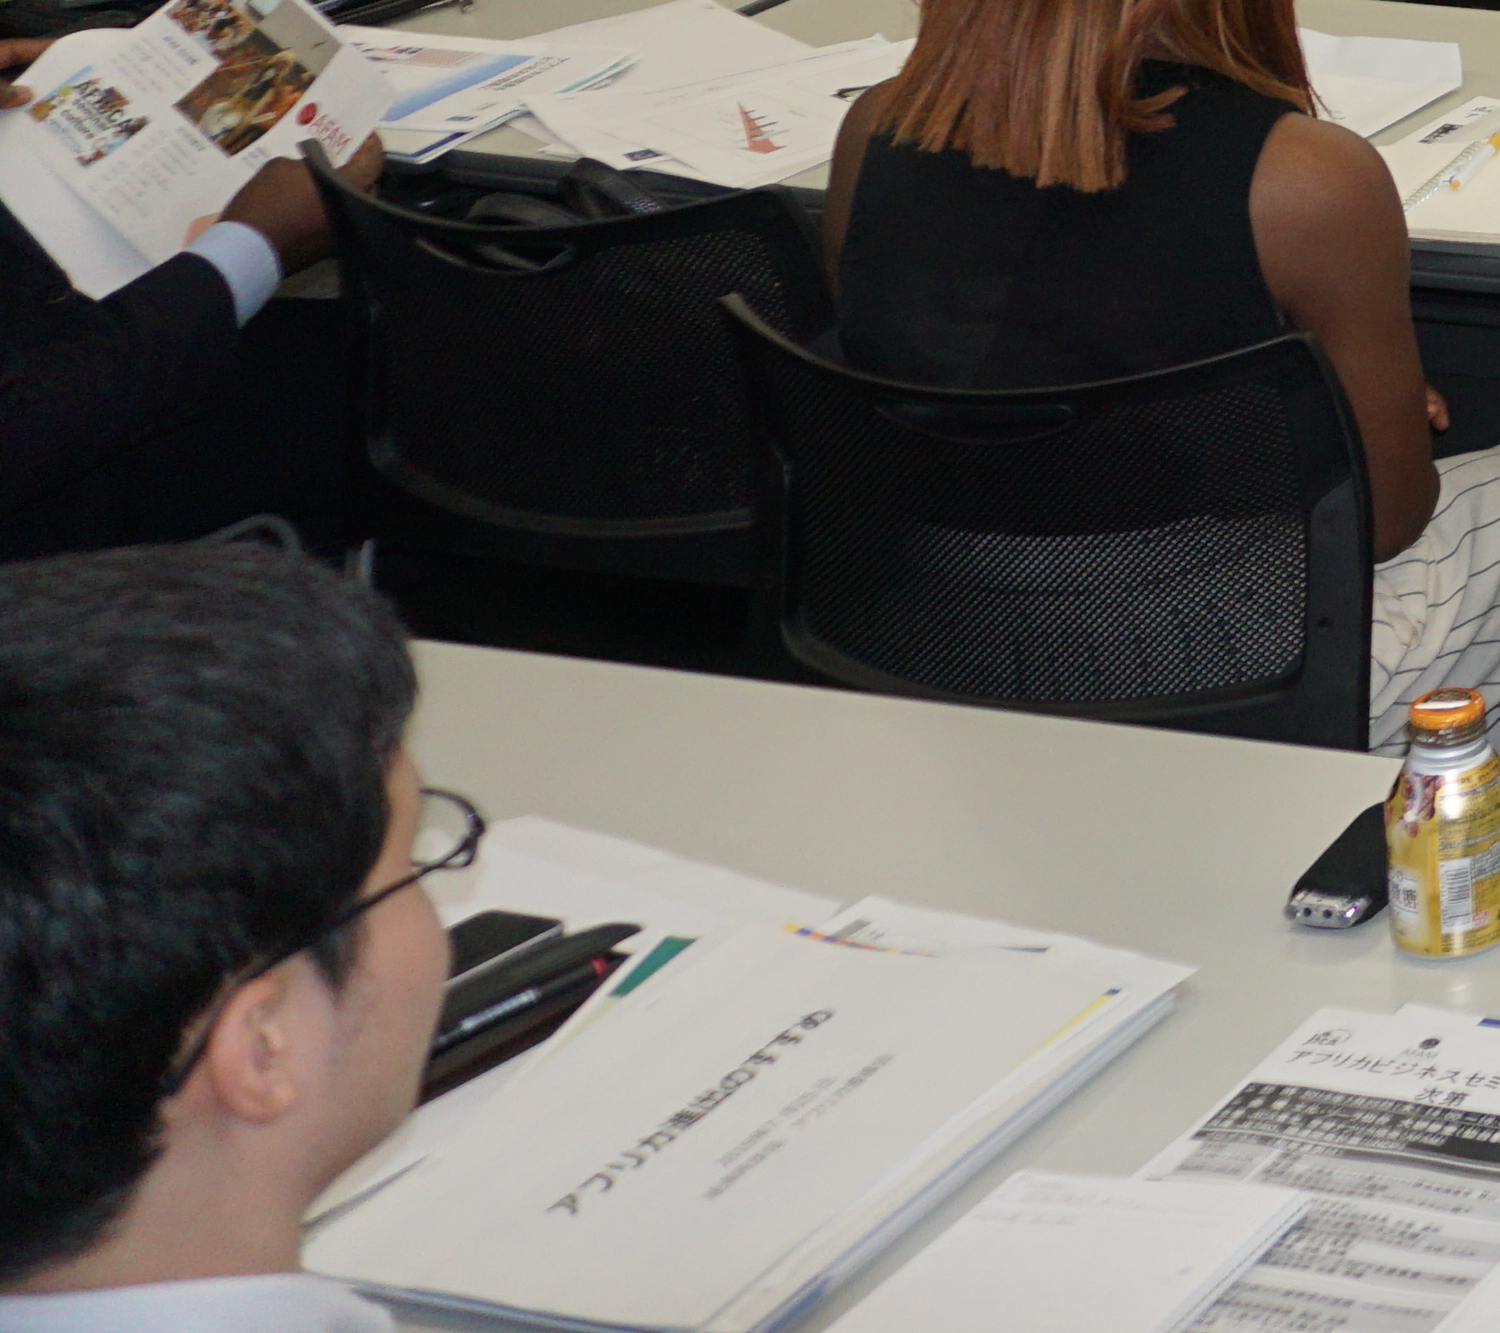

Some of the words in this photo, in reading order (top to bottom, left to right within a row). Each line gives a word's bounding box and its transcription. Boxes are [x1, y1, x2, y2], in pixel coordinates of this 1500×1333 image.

[545, 1007, 837, 1217] アフリカ進出のすすめ
[1413, 1084, 1472, 1107] 次第
